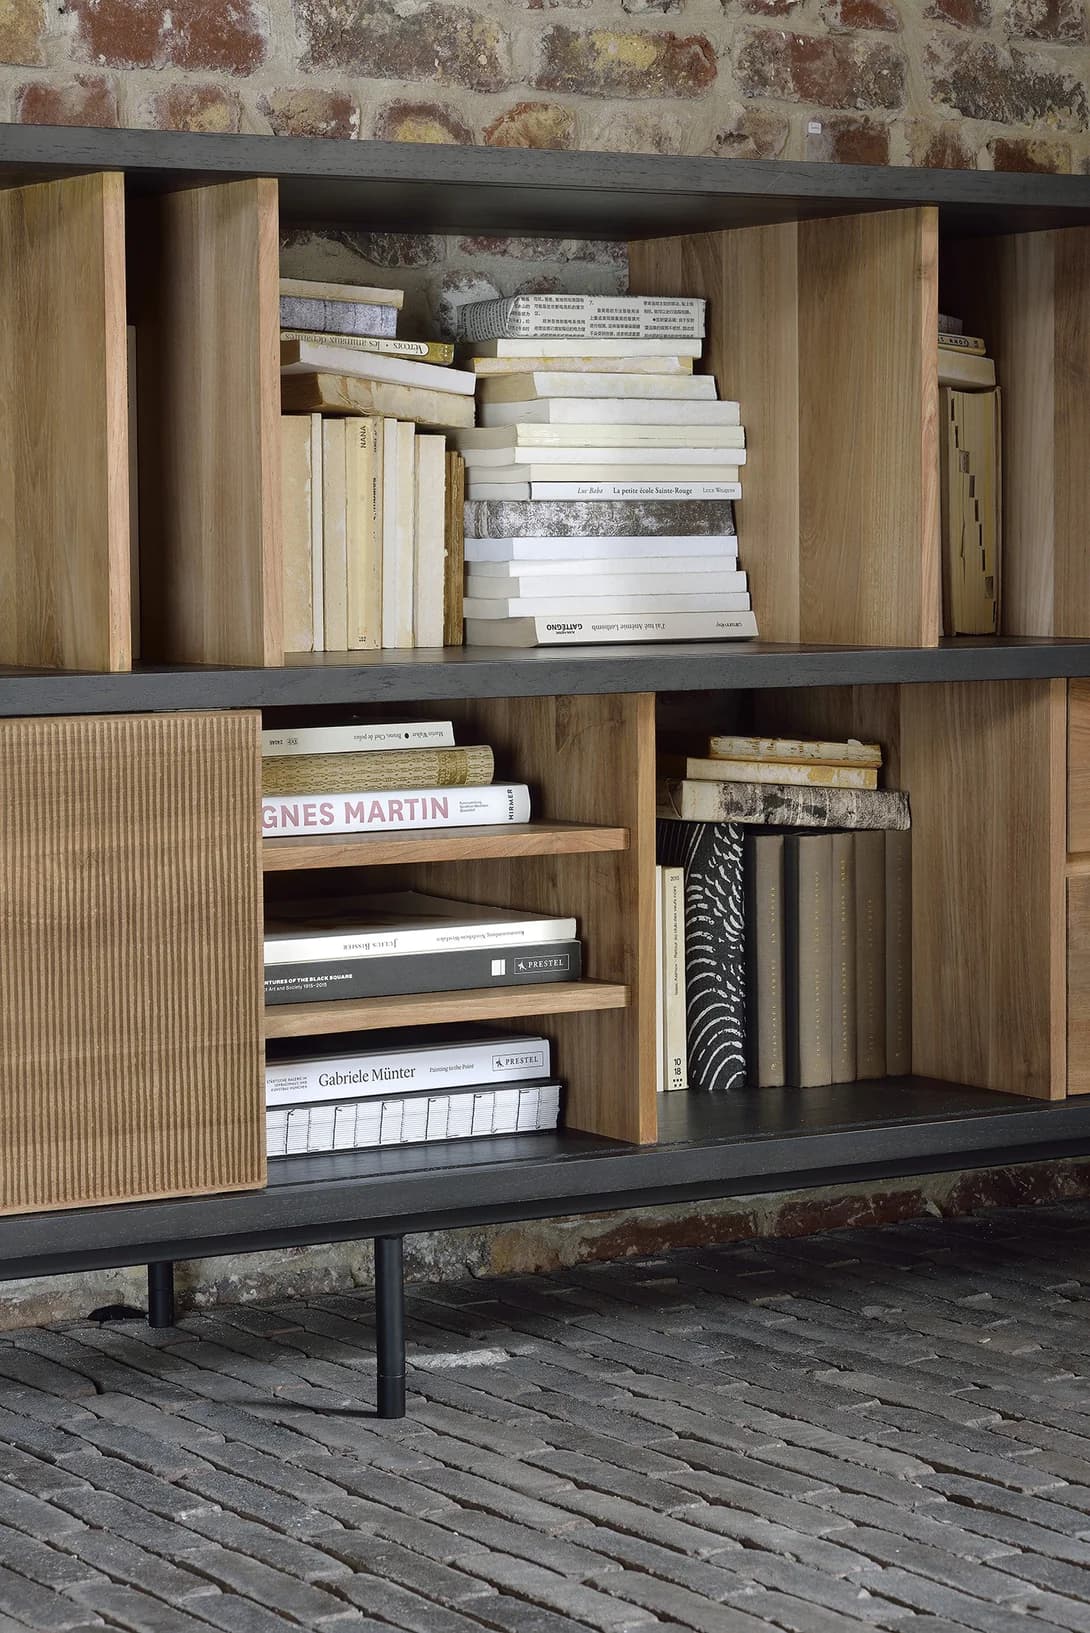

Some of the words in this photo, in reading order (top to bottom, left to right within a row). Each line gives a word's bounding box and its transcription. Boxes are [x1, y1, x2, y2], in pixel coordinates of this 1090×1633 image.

[393, 342, 423, 354] Vercors
[359, 425, 367, 449] NANA
[621, 487, 638, 497] petite
[655, 487, 693, 496] Sainte-Rouge
[546, 623, 583, 632] GATTÉGNO
[506, 788, 514, 821] HIRMER
[344, 796, 448, 825] MARTIN
[528, 958, 564, 969] PRESTEL
[329, 973, 353, 981] SQUARE
[505, 1055, 539, 1066] PRESTEL
[673, 1057, 682, 1066] 10
[318, 1069, 369, 1087] Gabriele
[371, 1066, 416, 1083] Münter
[673, 1067, 682, 1076] 18
